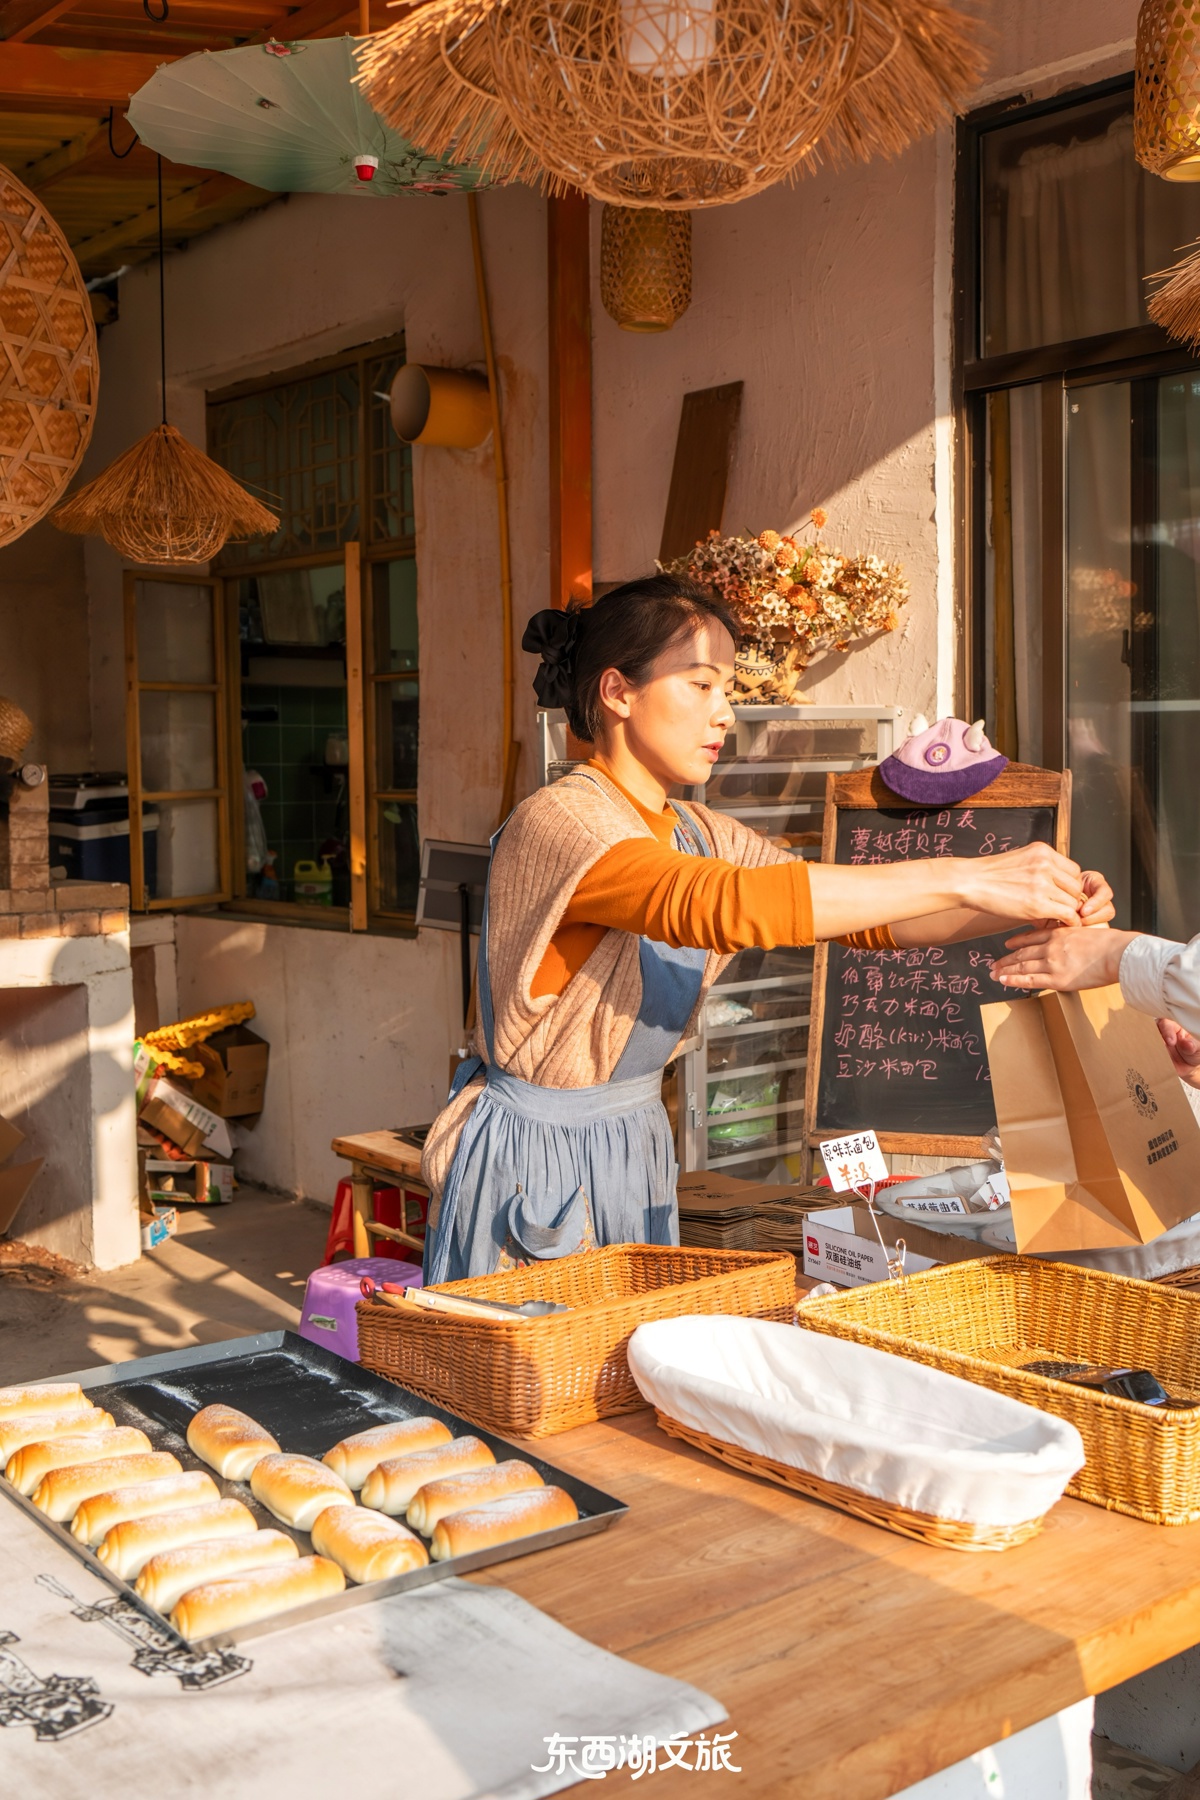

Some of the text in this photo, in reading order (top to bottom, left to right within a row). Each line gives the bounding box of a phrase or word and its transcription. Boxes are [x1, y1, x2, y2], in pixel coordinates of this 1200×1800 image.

[906, 810, 977, 830] 价目表
[850, 826, 954, 854] 蔓越莓贝果
[841, 994, 965, 1023] 巧克力米面包
[836, 1054, 939, 1080] 豆沙米面包
[822, 1135, 875, 1162] 原味米面包
[825, 1242, 874, 1263] SILICONE OIL PAPER
[825, 1250, 862, 1271] 双面硅油纸
